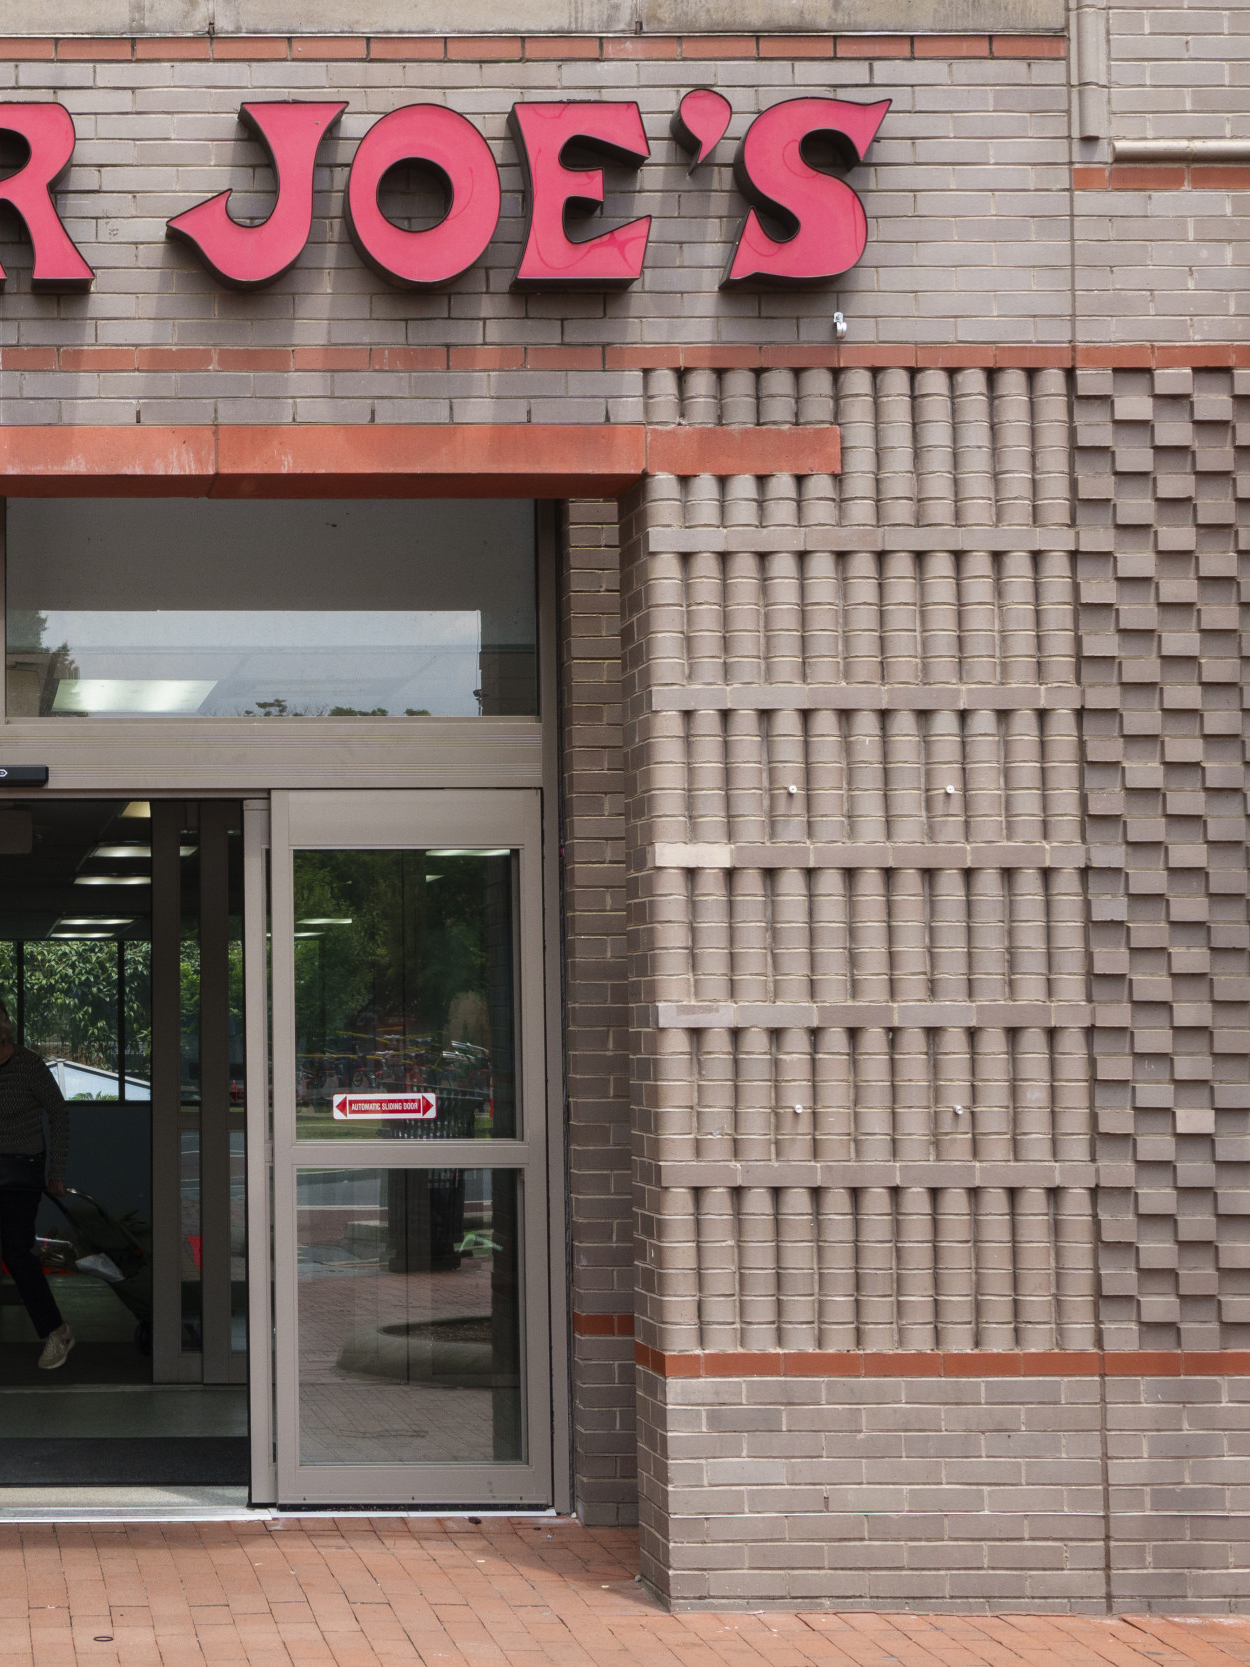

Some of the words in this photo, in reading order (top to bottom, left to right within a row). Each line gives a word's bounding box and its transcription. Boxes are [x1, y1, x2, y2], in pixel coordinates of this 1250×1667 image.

[165, 88, 893, 292] JOE'S
[352, 1103, 380, 1111] AUTOMATIC
[381, 1102, 402, 1110] SLIDING
[403, 1102, 418, 1110] DOOR
